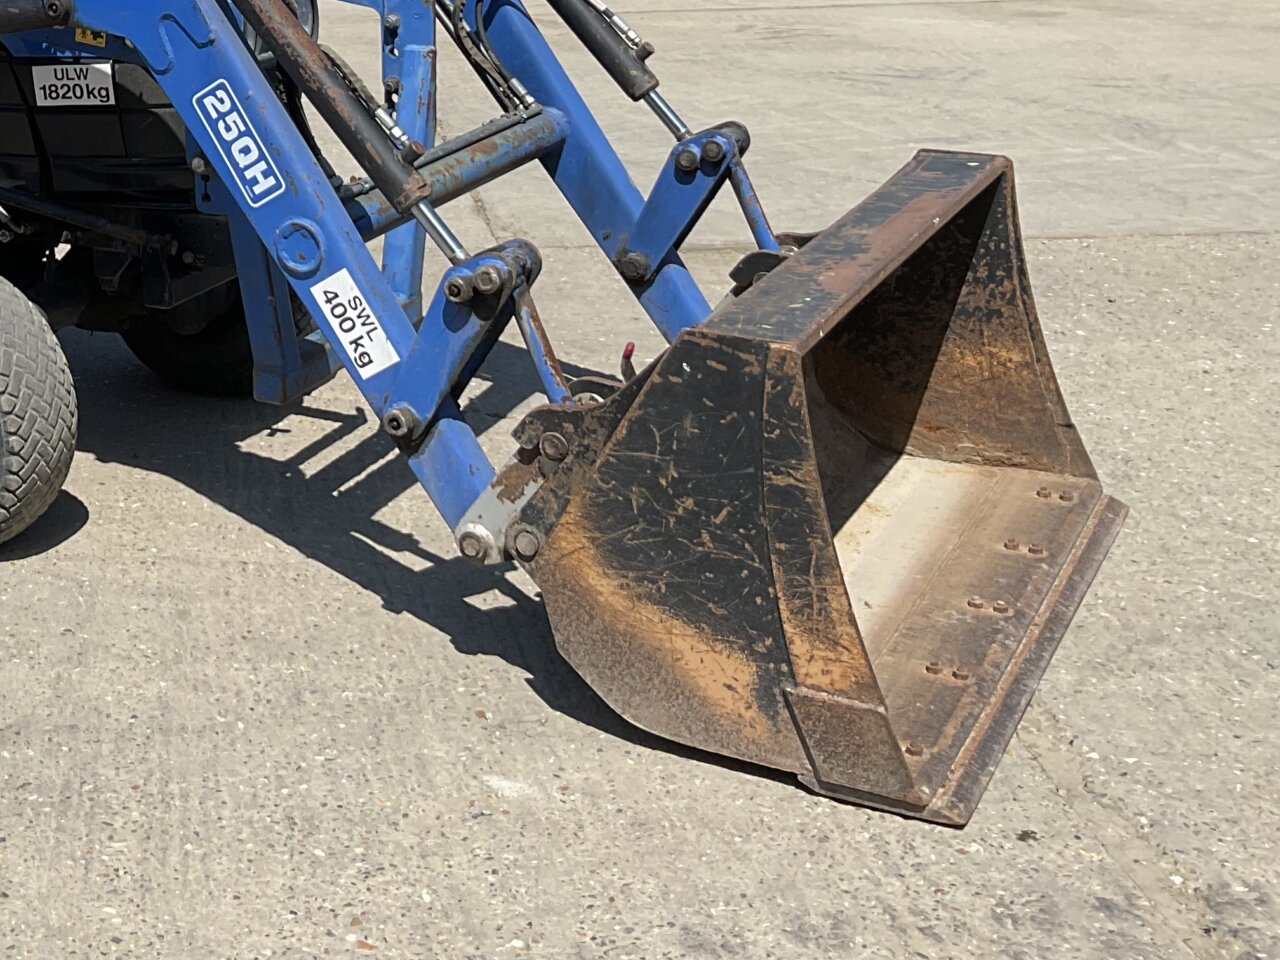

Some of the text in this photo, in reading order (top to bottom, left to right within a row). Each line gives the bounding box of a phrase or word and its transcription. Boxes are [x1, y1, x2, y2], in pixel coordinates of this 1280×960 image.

[53, 67, 89, 81] ULW
[322, 290, 374, 369] 400 kg
[348, 295, 378, 342] SWL
